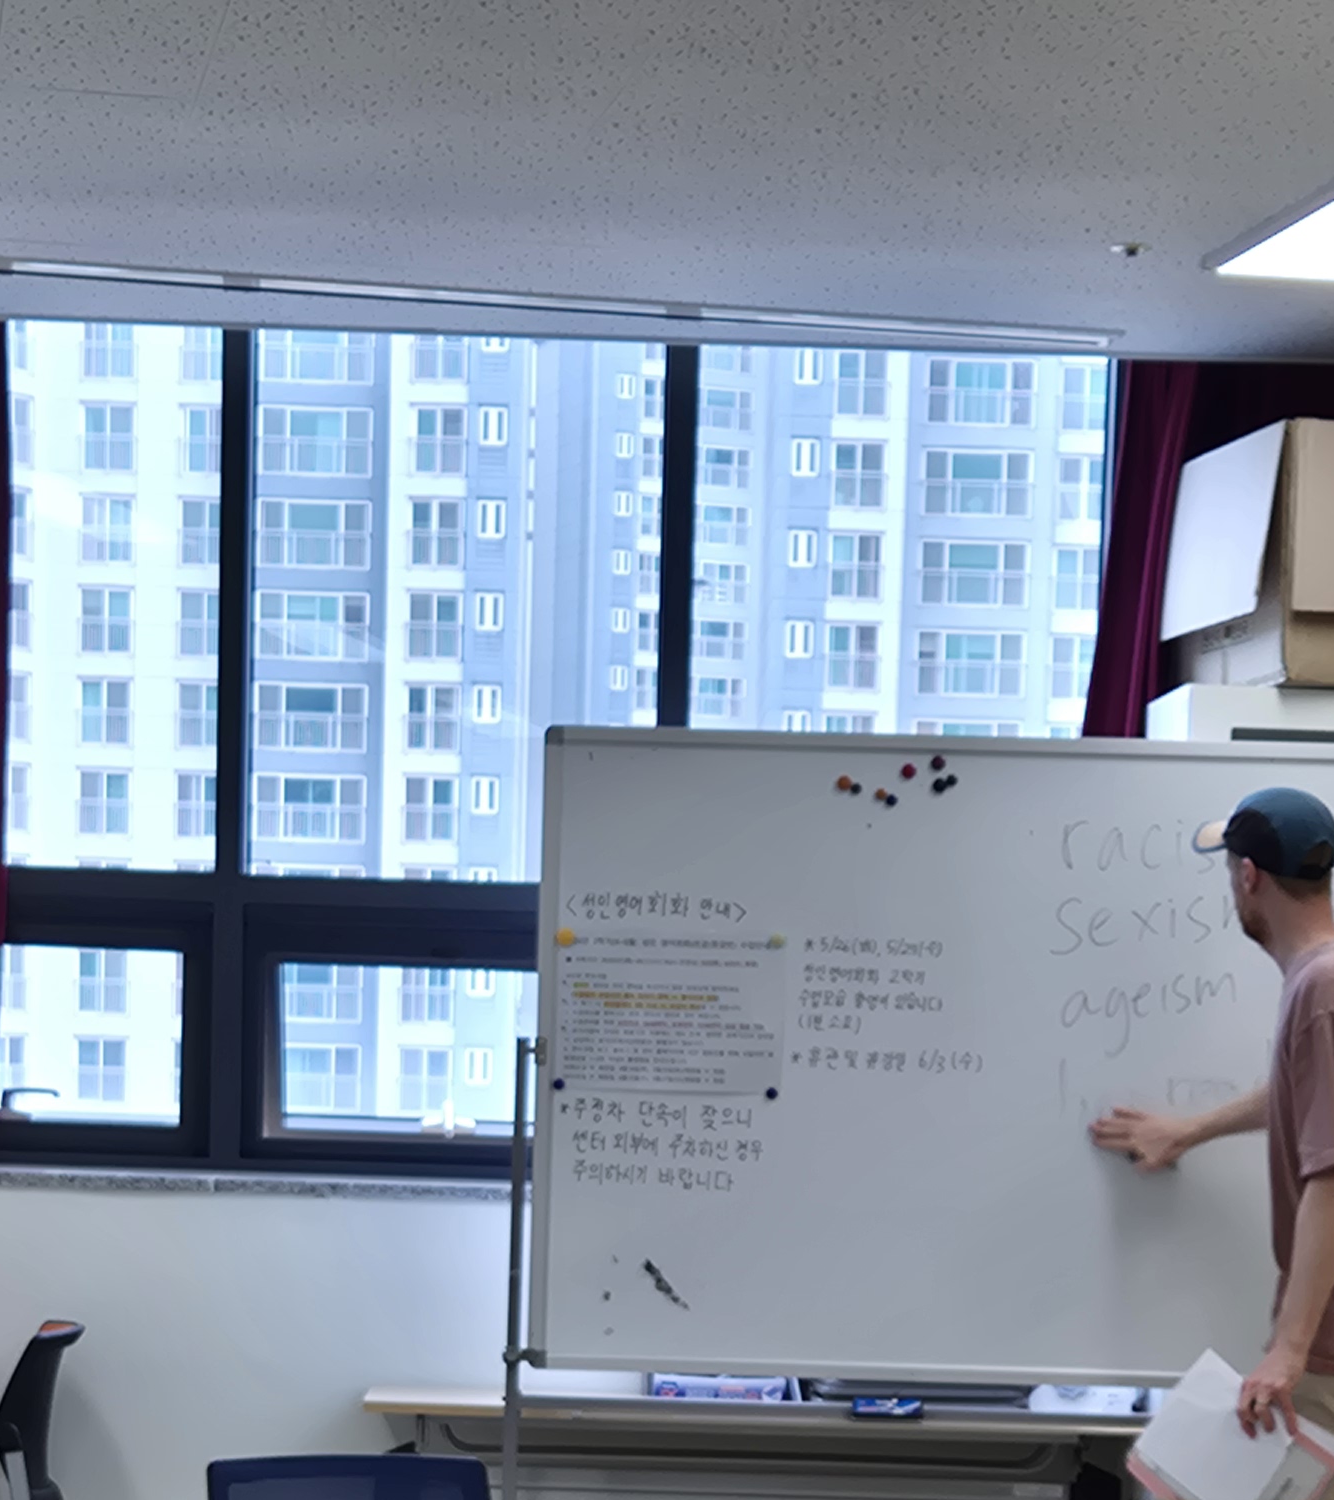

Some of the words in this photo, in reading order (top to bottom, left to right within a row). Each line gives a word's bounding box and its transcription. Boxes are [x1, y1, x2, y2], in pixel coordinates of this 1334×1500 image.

[1061, 818, 1217, 875] racis
[1061, 971, 1238, 1059] ageism
[573, 1097, 626, 1124] 주정차
[639, 1101, 688, 1129] 단속이
[700, 1104, 753, 1131] 잦으니
[572, 1158, 649, 1186] 주의하시기
[657, 1167, 734, 1192] 바랍니다
